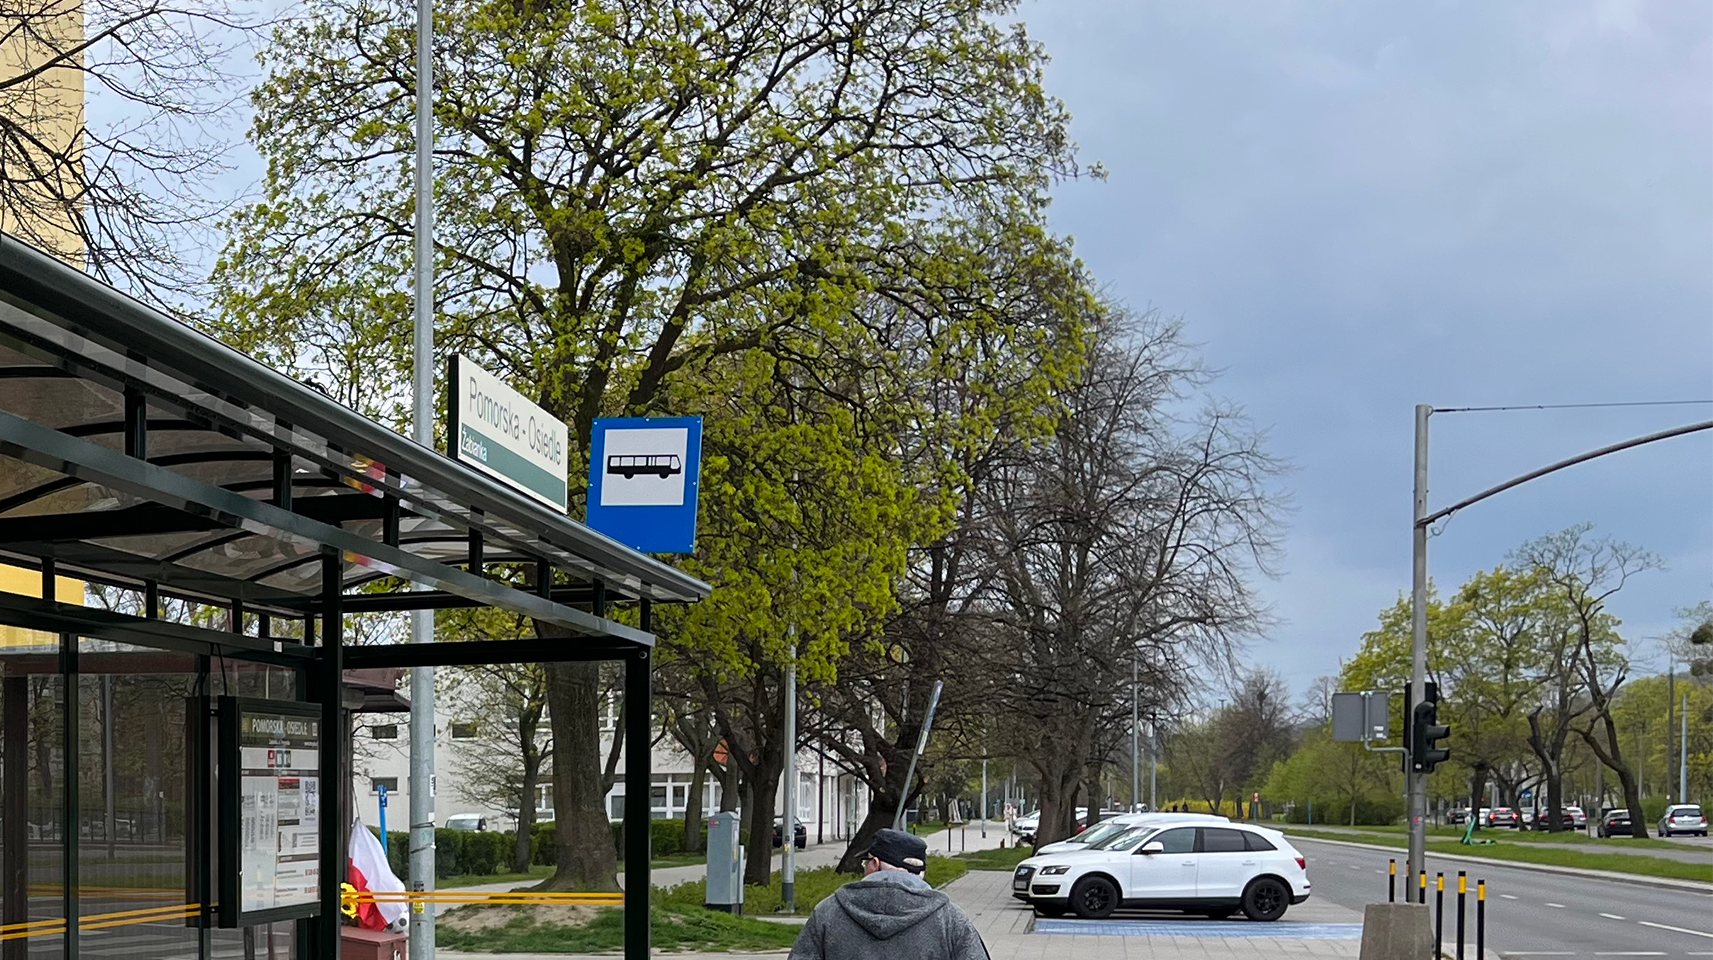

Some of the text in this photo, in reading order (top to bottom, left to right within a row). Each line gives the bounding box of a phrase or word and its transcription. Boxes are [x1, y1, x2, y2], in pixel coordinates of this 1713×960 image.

[469, 376, 520, 441] Pomorska
[528, 415, 562, 466] Osiedle
[252, 718, 284, 734] POMORSKA
[286, 720, 308, 735] OSIEDLE
